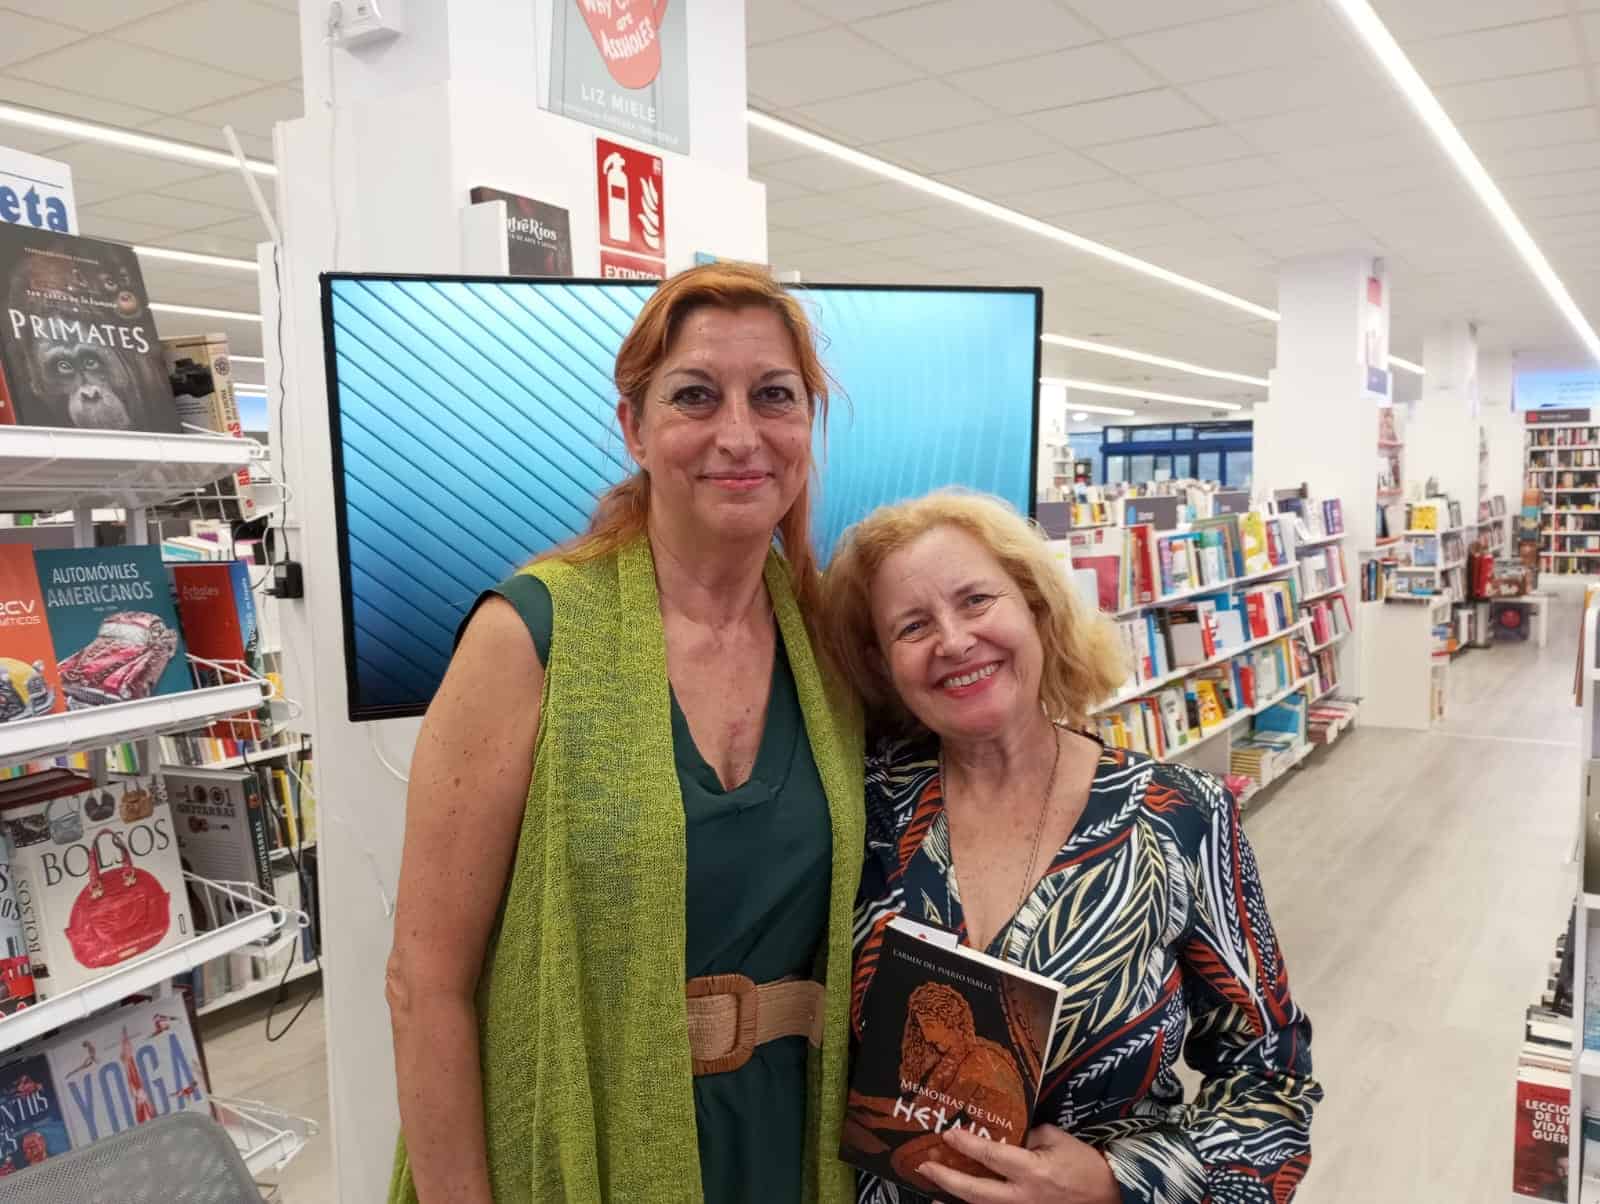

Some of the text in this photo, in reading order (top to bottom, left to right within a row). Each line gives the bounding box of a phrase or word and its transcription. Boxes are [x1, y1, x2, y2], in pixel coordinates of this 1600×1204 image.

[581, 82, 656, 124] LIZ MIELE
[8, 308, 149, 353] PRIMATES
[48, 581, 154, 607] AMERICANOS
[53, 562, 139, 584] AUTOMÓVILES
[40, 818, 170, 887] BOLSOS
[68, 1032, 201, 1142] YOGA
[900, 1079, 1013, 1131] MEMORIAS DE UNA
[1533, 1119, 1566, 1133] VIDA
[1535, 1110, 1551, 1122] DE
